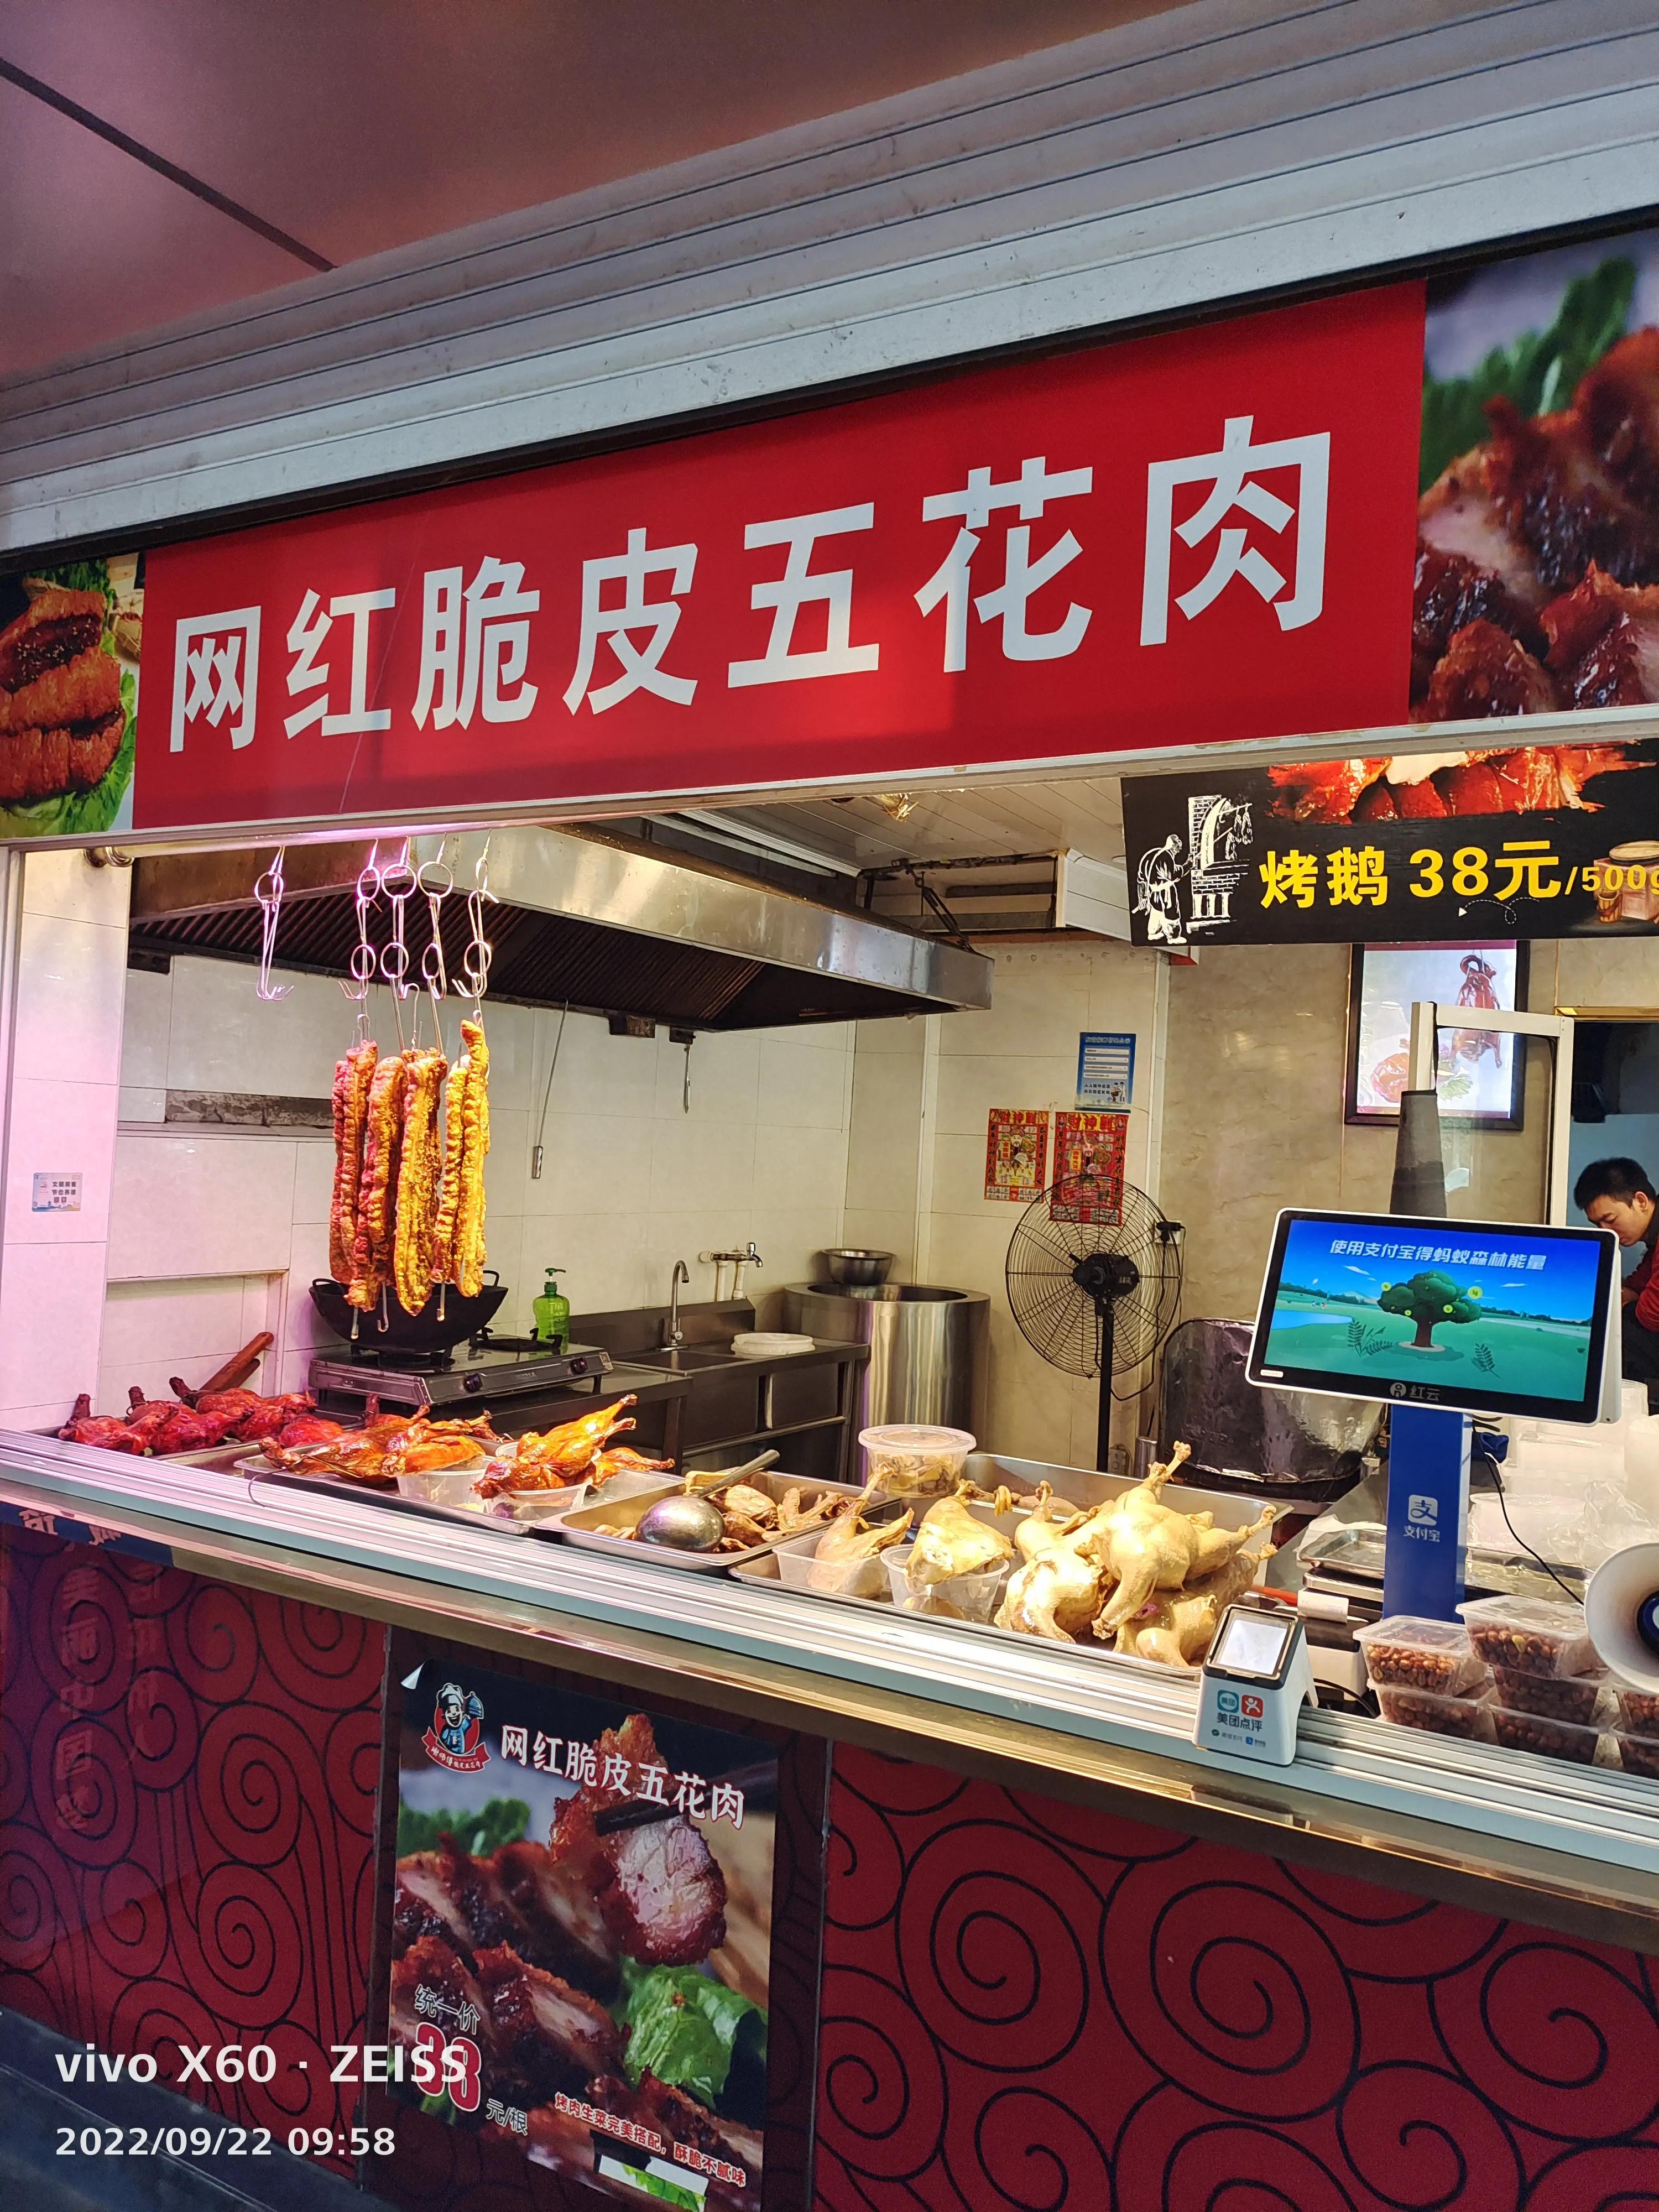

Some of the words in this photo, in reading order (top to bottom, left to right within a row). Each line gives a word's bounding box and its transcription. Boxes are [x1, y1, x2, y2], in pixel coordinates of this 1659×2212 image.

[169, 415, 1331, 753] 网红脆皮五花肉
[1260, 846, 1388, 909] 烤鹅
[1329, 1239, 1547, 1270] 使用支付宝得蚂蚁森林能量
[1410, 1385, 1441, 1401] 红云
[1403, 1525, 1440, 1543] 支付宝
[1217, 1712, 1262, 1732] 美团点评
[501, 1725, 745, 1829] 网红脆皮五花肉
[415, 1984, 481, 2035] 统一价
[486, 2098, 528, 2136] 元/根
